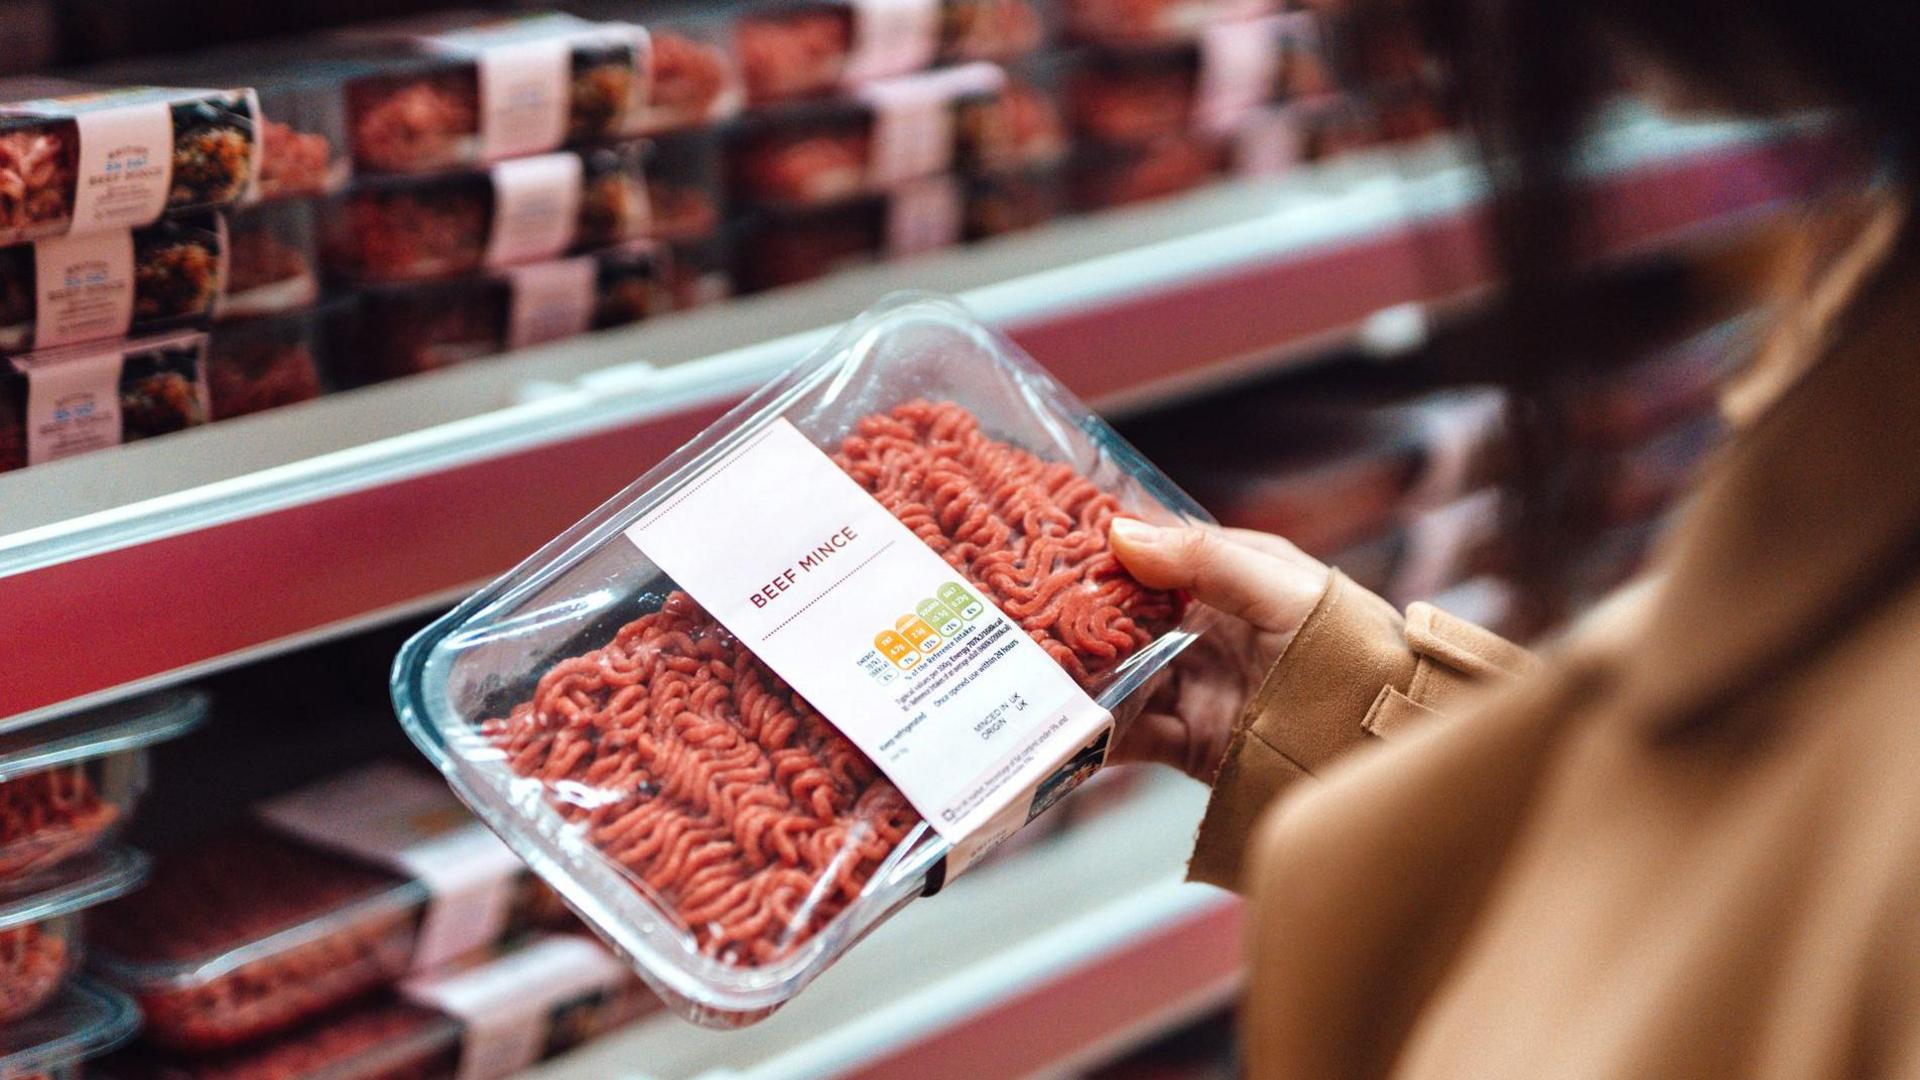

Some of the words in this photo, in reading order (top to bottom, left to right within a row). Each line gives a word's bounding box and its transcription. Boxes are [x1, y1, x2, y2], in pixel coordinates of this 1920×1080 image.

[749, 568, 798, 608] BEEF
[799, 526, 858, 572] MINCE
[916, 661, 928, 671] the
[925, 639, 955, 664] Reference
[952, 623, 976, 643] Intakes
[946, 677, 971, 697] opened
[967, 669, 980, 681] use
[976, 655, 997, 673] within
[993, 649, 1004, 659] 24
[999, 637, 1019, 654] hours
[948, 644, 971, 663] Energy
[972, 707, 1003, 733] MINCED
[1006, 691, 1022, 704] UK
[979, 716, 1008, 740] ORIGIN
[1013, 698, 1029, 711] UK
